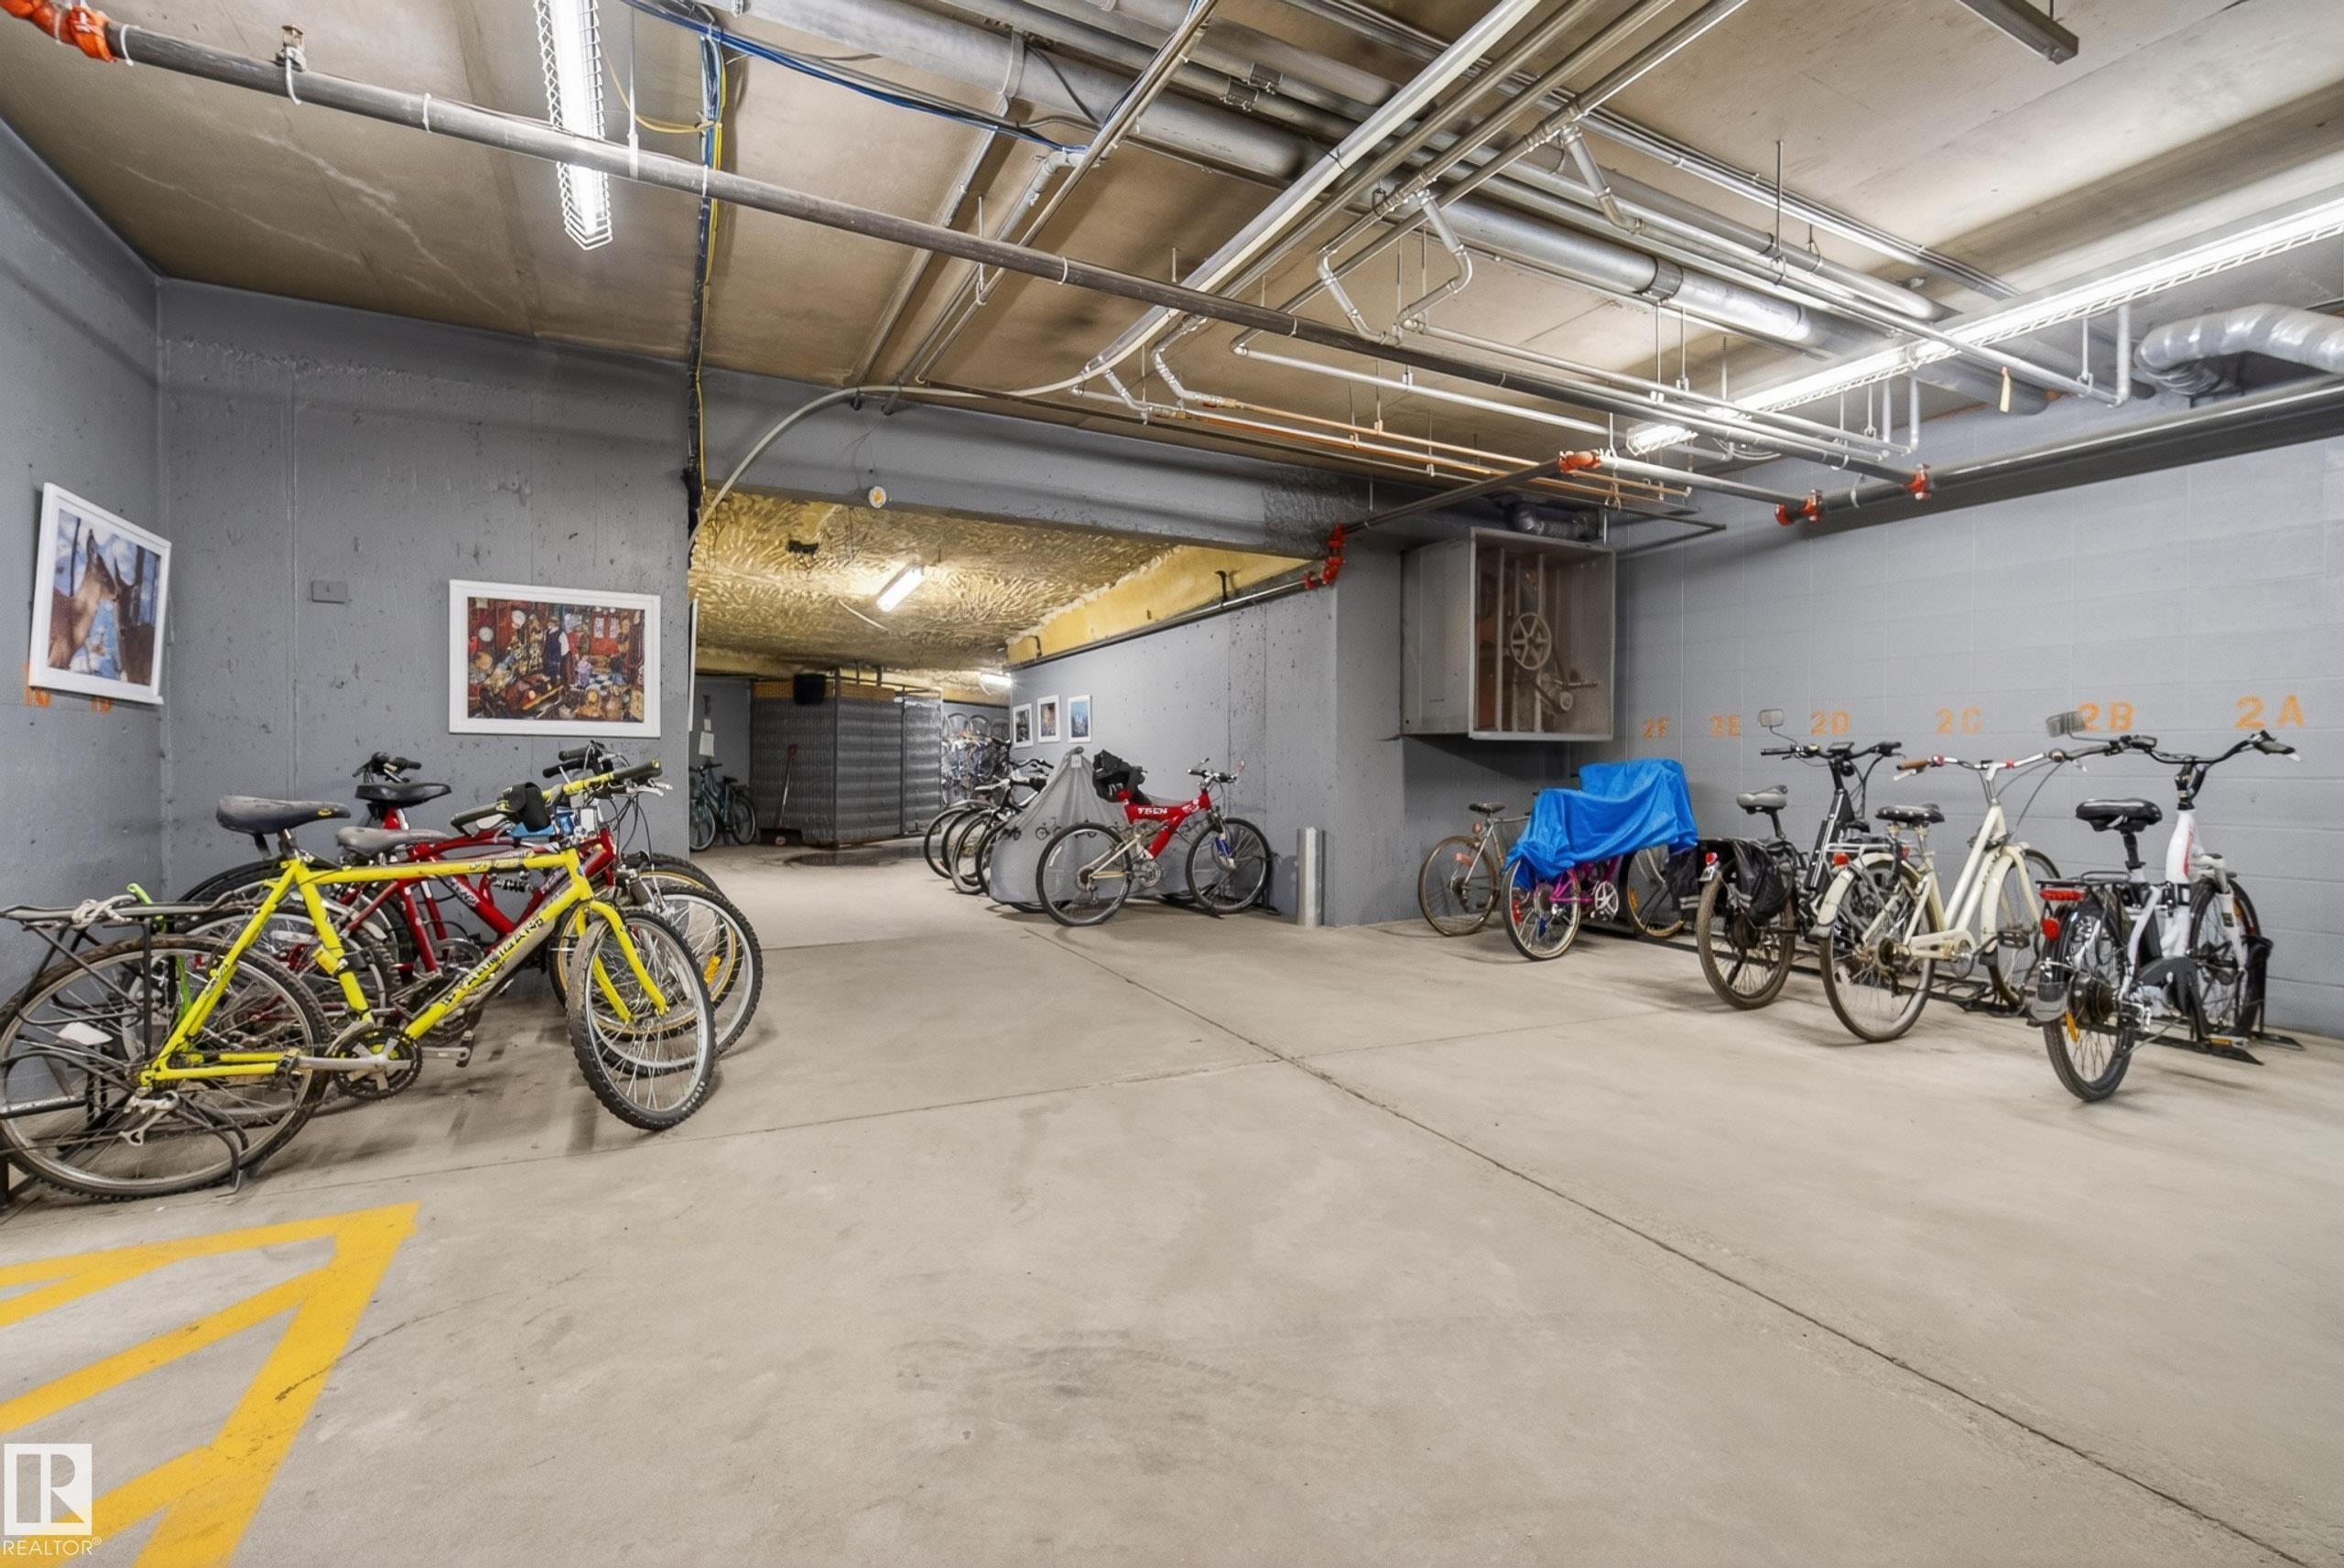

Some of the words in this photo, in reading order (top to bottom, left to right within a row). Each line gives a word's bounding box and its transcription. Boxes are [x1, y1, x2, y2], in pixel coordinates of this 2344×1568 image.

[1810, 709, 1850, 736] 2D
[1935, 708, 1982, 734] 2C
[2076, 701, 2135, 732] 2B
[2234, 693, 2306, 730] 2A
